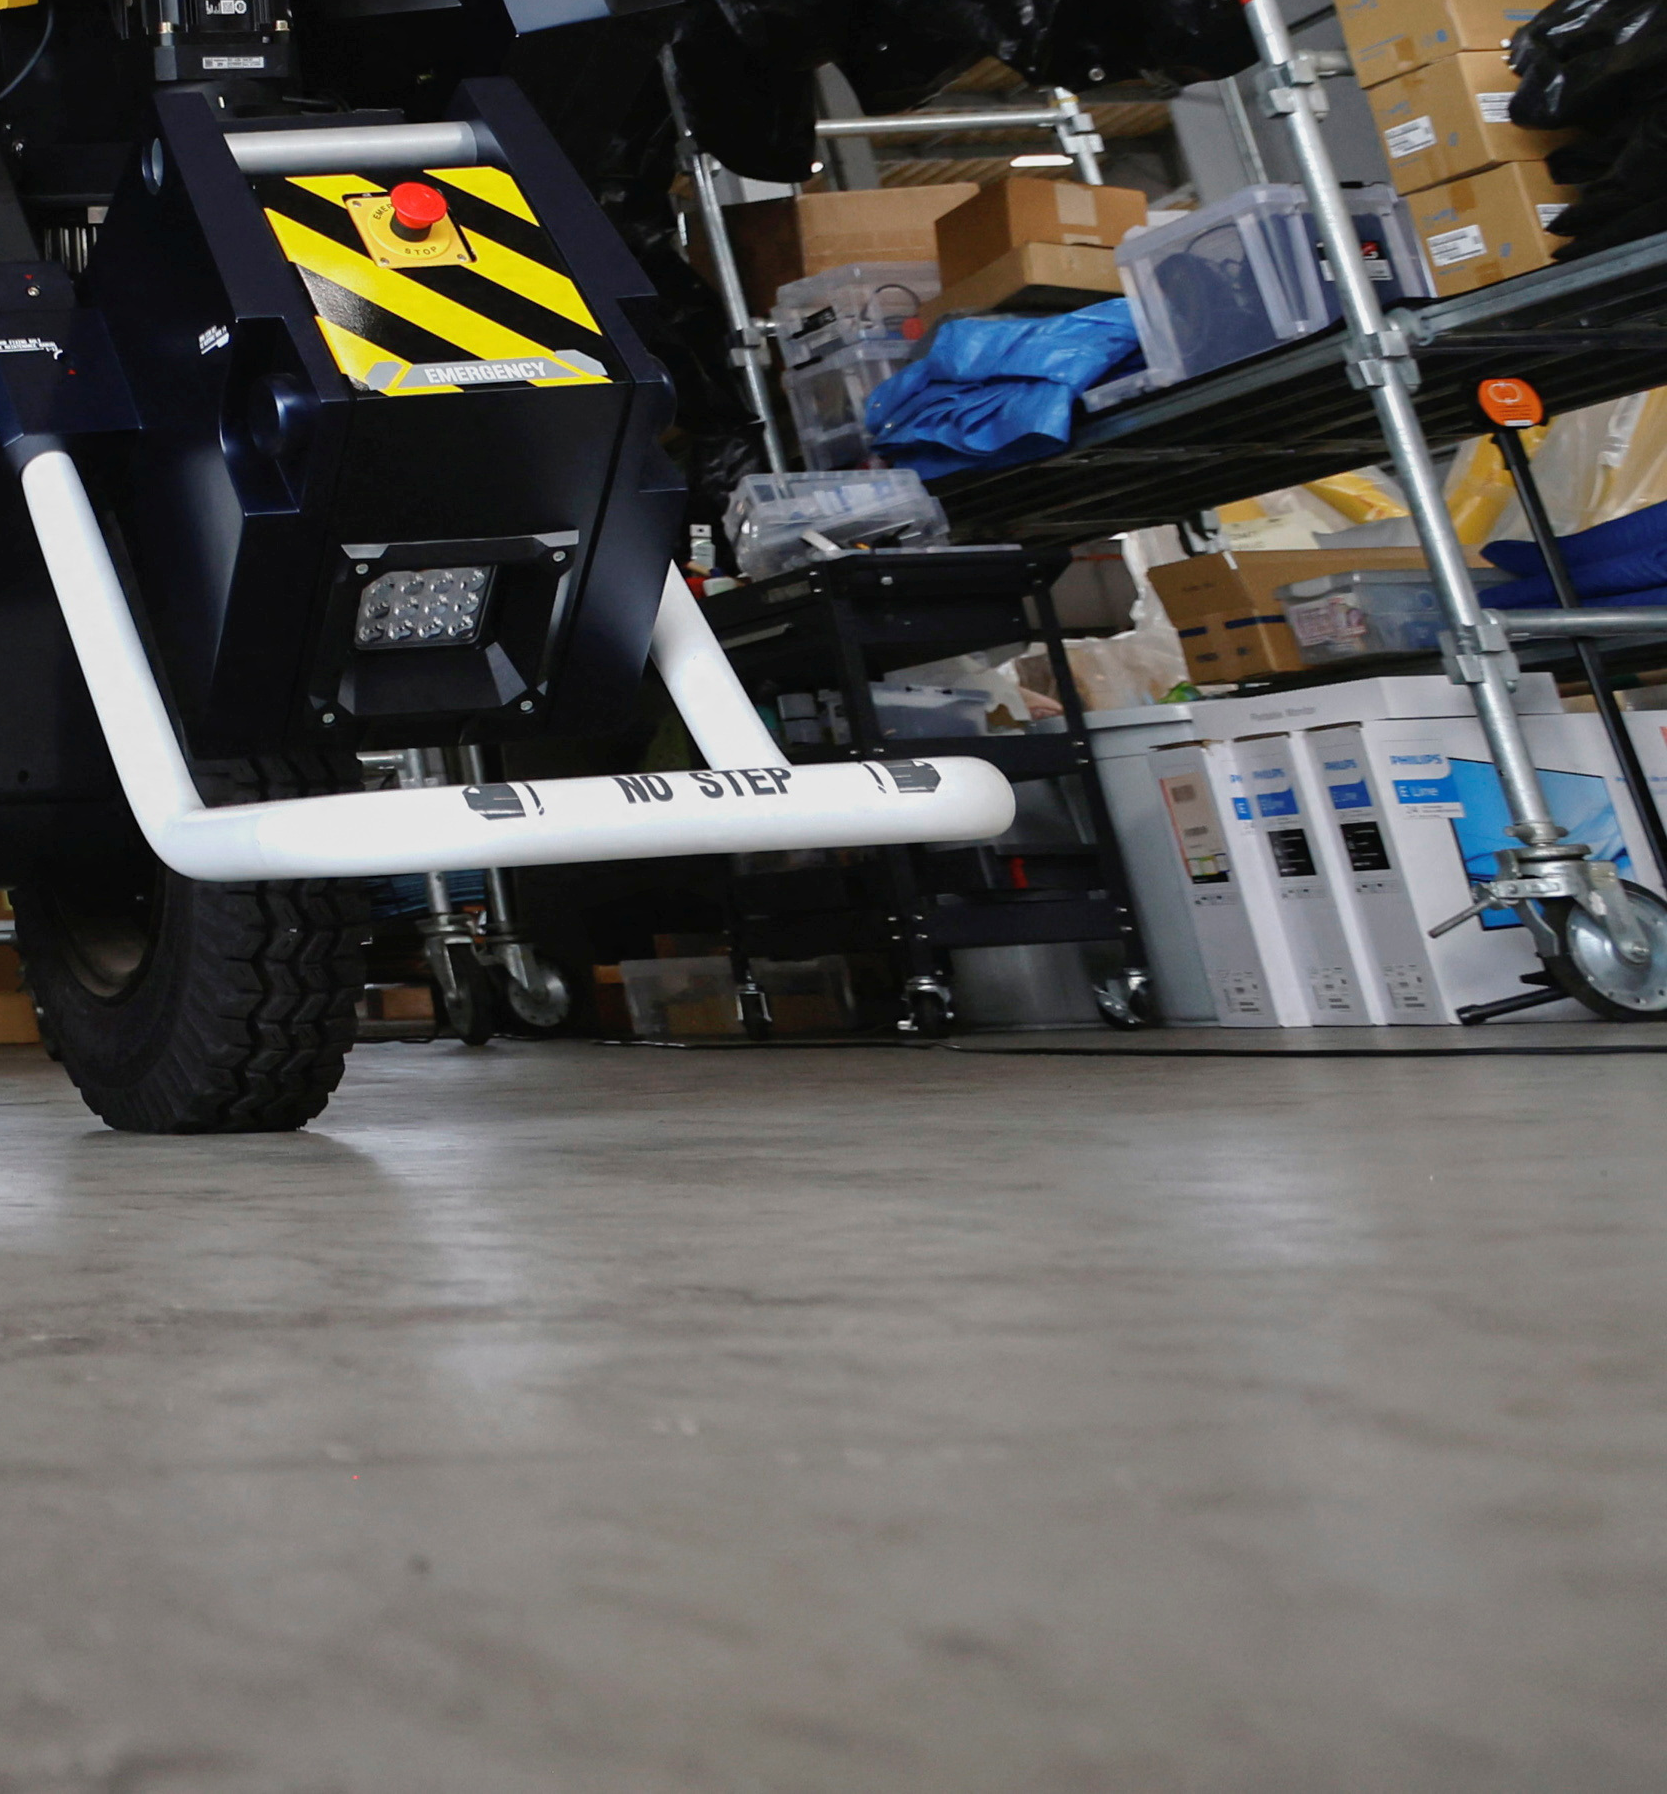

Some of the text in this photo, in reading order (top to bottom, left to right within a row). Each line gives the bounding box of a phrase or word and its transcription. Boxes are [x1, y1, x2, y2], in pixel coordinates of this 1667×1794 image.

[405, 246, 437, 256] STOP
[424, 362, 546, 383] EMERGENCY
[1389, 754, 1443, 765] PHILIPS
[614, 767, 793, 803] NO STEP
[1399, 786, 1410, 797] E
